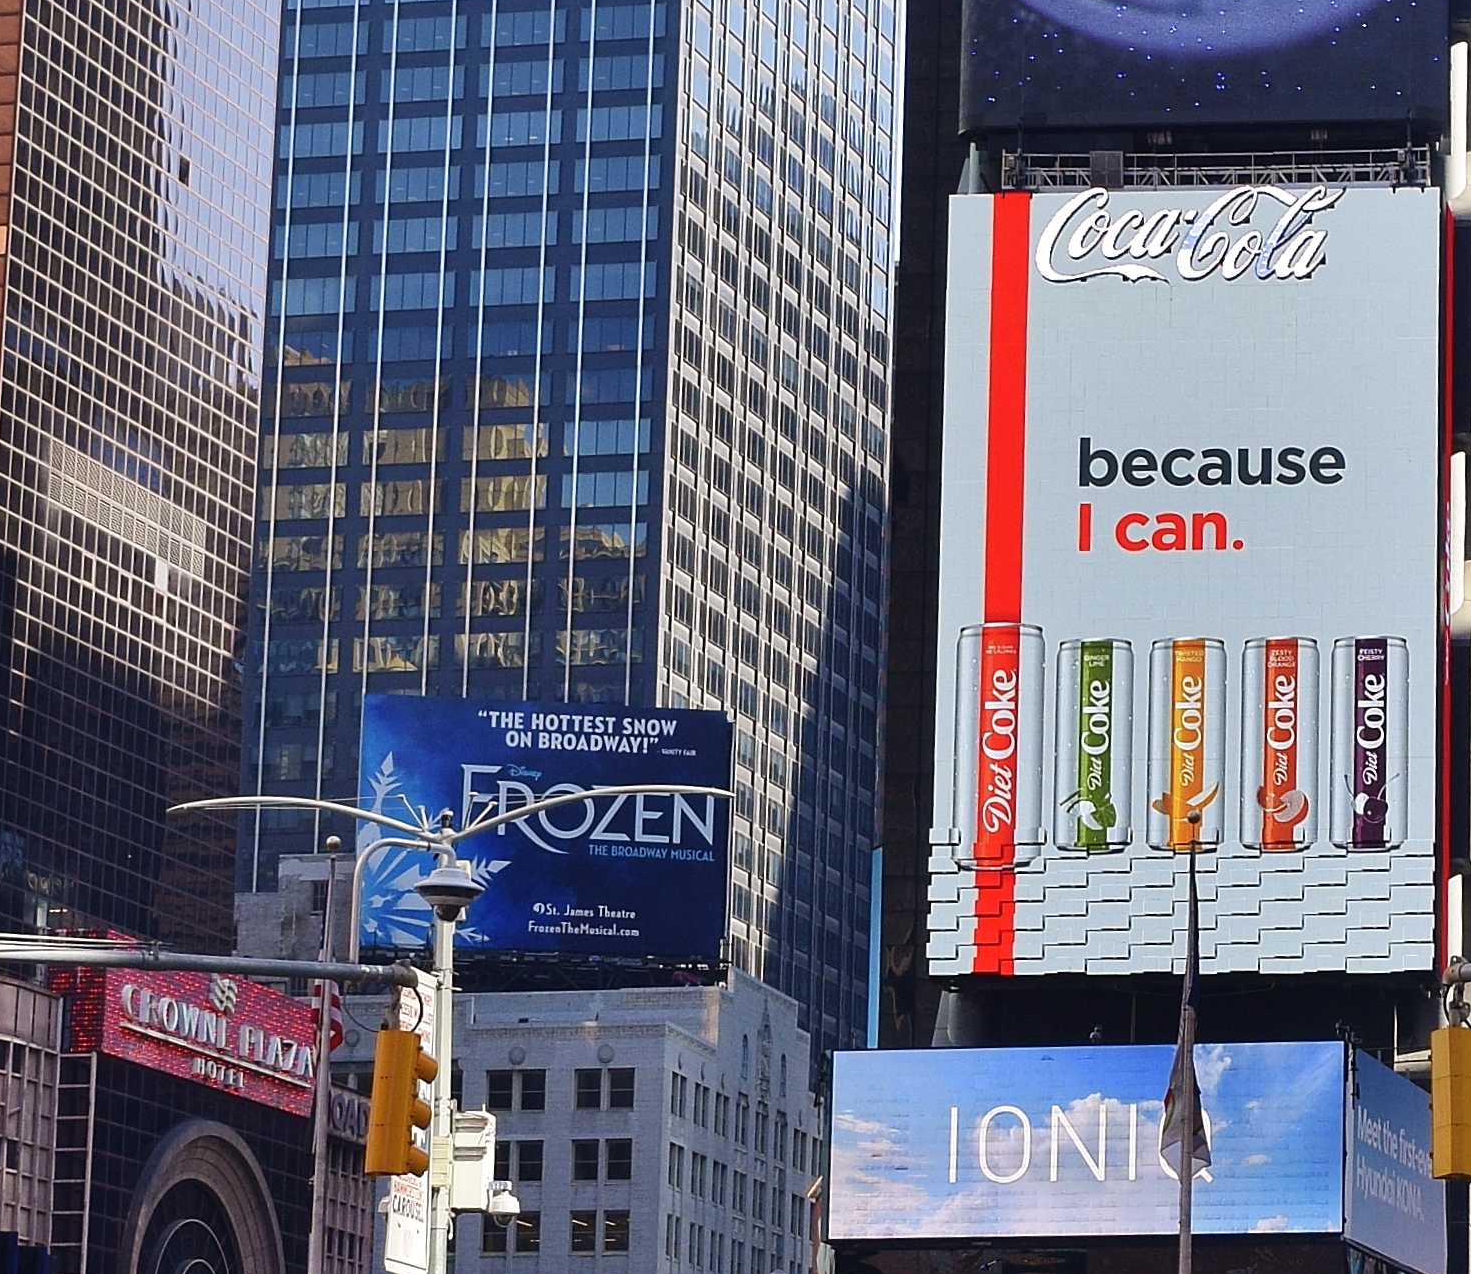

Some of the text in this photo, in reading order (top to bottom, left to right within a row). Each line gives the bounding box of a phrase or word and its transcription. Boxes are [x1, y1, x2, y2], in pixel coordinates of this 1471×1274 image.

[1077, 436, 1346, 491] because
[1078, 503, 1246, 554] I can.
[505, 730, 532, 748] ON
[531, 712, 617, 735] HOTTEST
[621, 717, 677, 737] SNOW
[982, 669, 1018, 761] Coke
[1080, 679, 1111, 756] Coke
[1174, 674, 1204, 753] Coke
[1266, 674, 1297, 752] Coke
[1356, 673, 1386, 751] Coke
[461, 763, 716, 855] FROZEN
[983, 761, 1013, 834] Diet
[588, 844, 716, 863] THE BROADWAY MUSICAL
[527, 921, 640, 938] FrozenTheMusical.com
[563, 904, 595, 919] James
[597, 905, 637, 920] Theatre
[238, 1024, 315, 1079] PLAZA
[1356, 1153, 1396, 1207] Hyundai
